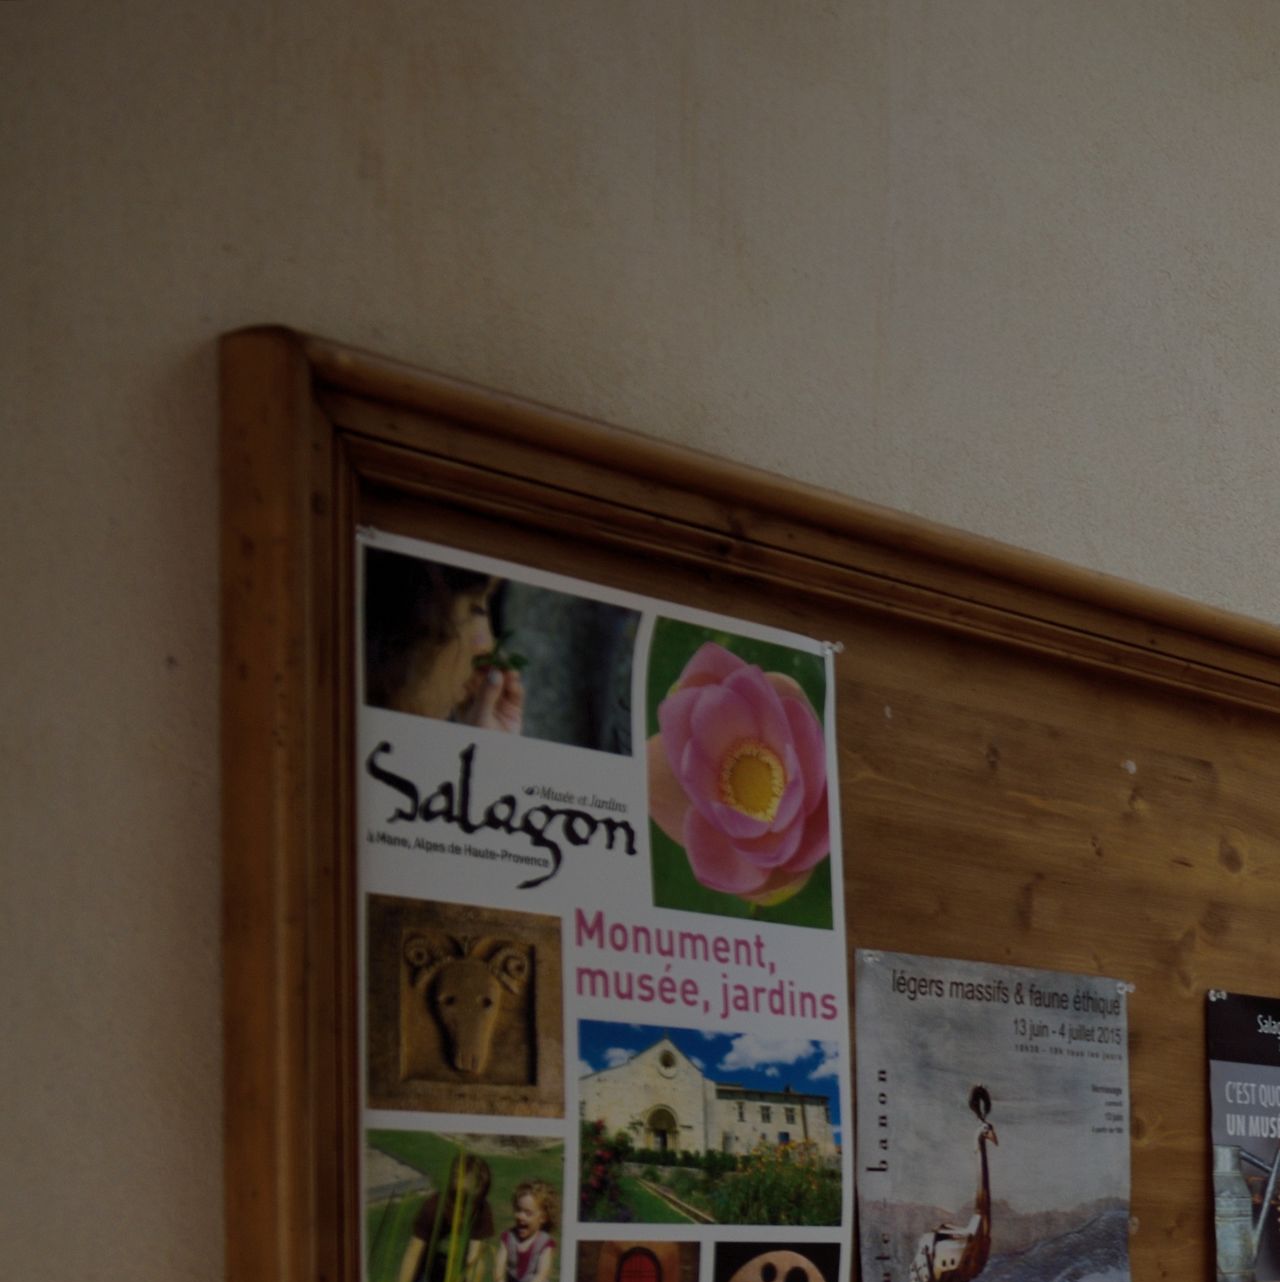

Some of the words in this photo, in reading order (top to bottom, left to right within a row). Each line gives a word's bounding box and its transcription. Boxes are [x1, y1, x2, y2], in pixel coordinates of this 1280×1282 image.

[367, 741, 637, 889] Salagon
[540, 787, 575, 804] Musée
[590, 795, 627, 812] Jardins
[376, 832, 411, 849] Mane,
[413, 837, 445, 854] Alpes
[448, 843, 462, 855] de
[464, 844, 549, 868] Haute-Provence
[575, 907, 776, 975] Monument,
[576, 964, 710, 1014] musée,
[720, 974, 838, 1020] jardins
[892, 969, 944, 1001] légers
[949, 979, 1010, 1003] massifs
[1014, 982, 1025, 1005] &
[1029, 985, 1069, 1010] faune
[1073, 990, 1121, 1019] éthique
[1013, 1019, 1027, 1036] 13
[1029, 1022, 1050, 1041] juin
[1058, 1023, 1066, 1038] 4
[1068, 1025, 1096, 1044] juillet
[1097, 1028, 1122, 1045] 2015
[1225, 1081, 1256, 1105] C'EST
[866, 1070, 887, 1172] banon
[1226, 1113, 1247, 1136] UN
